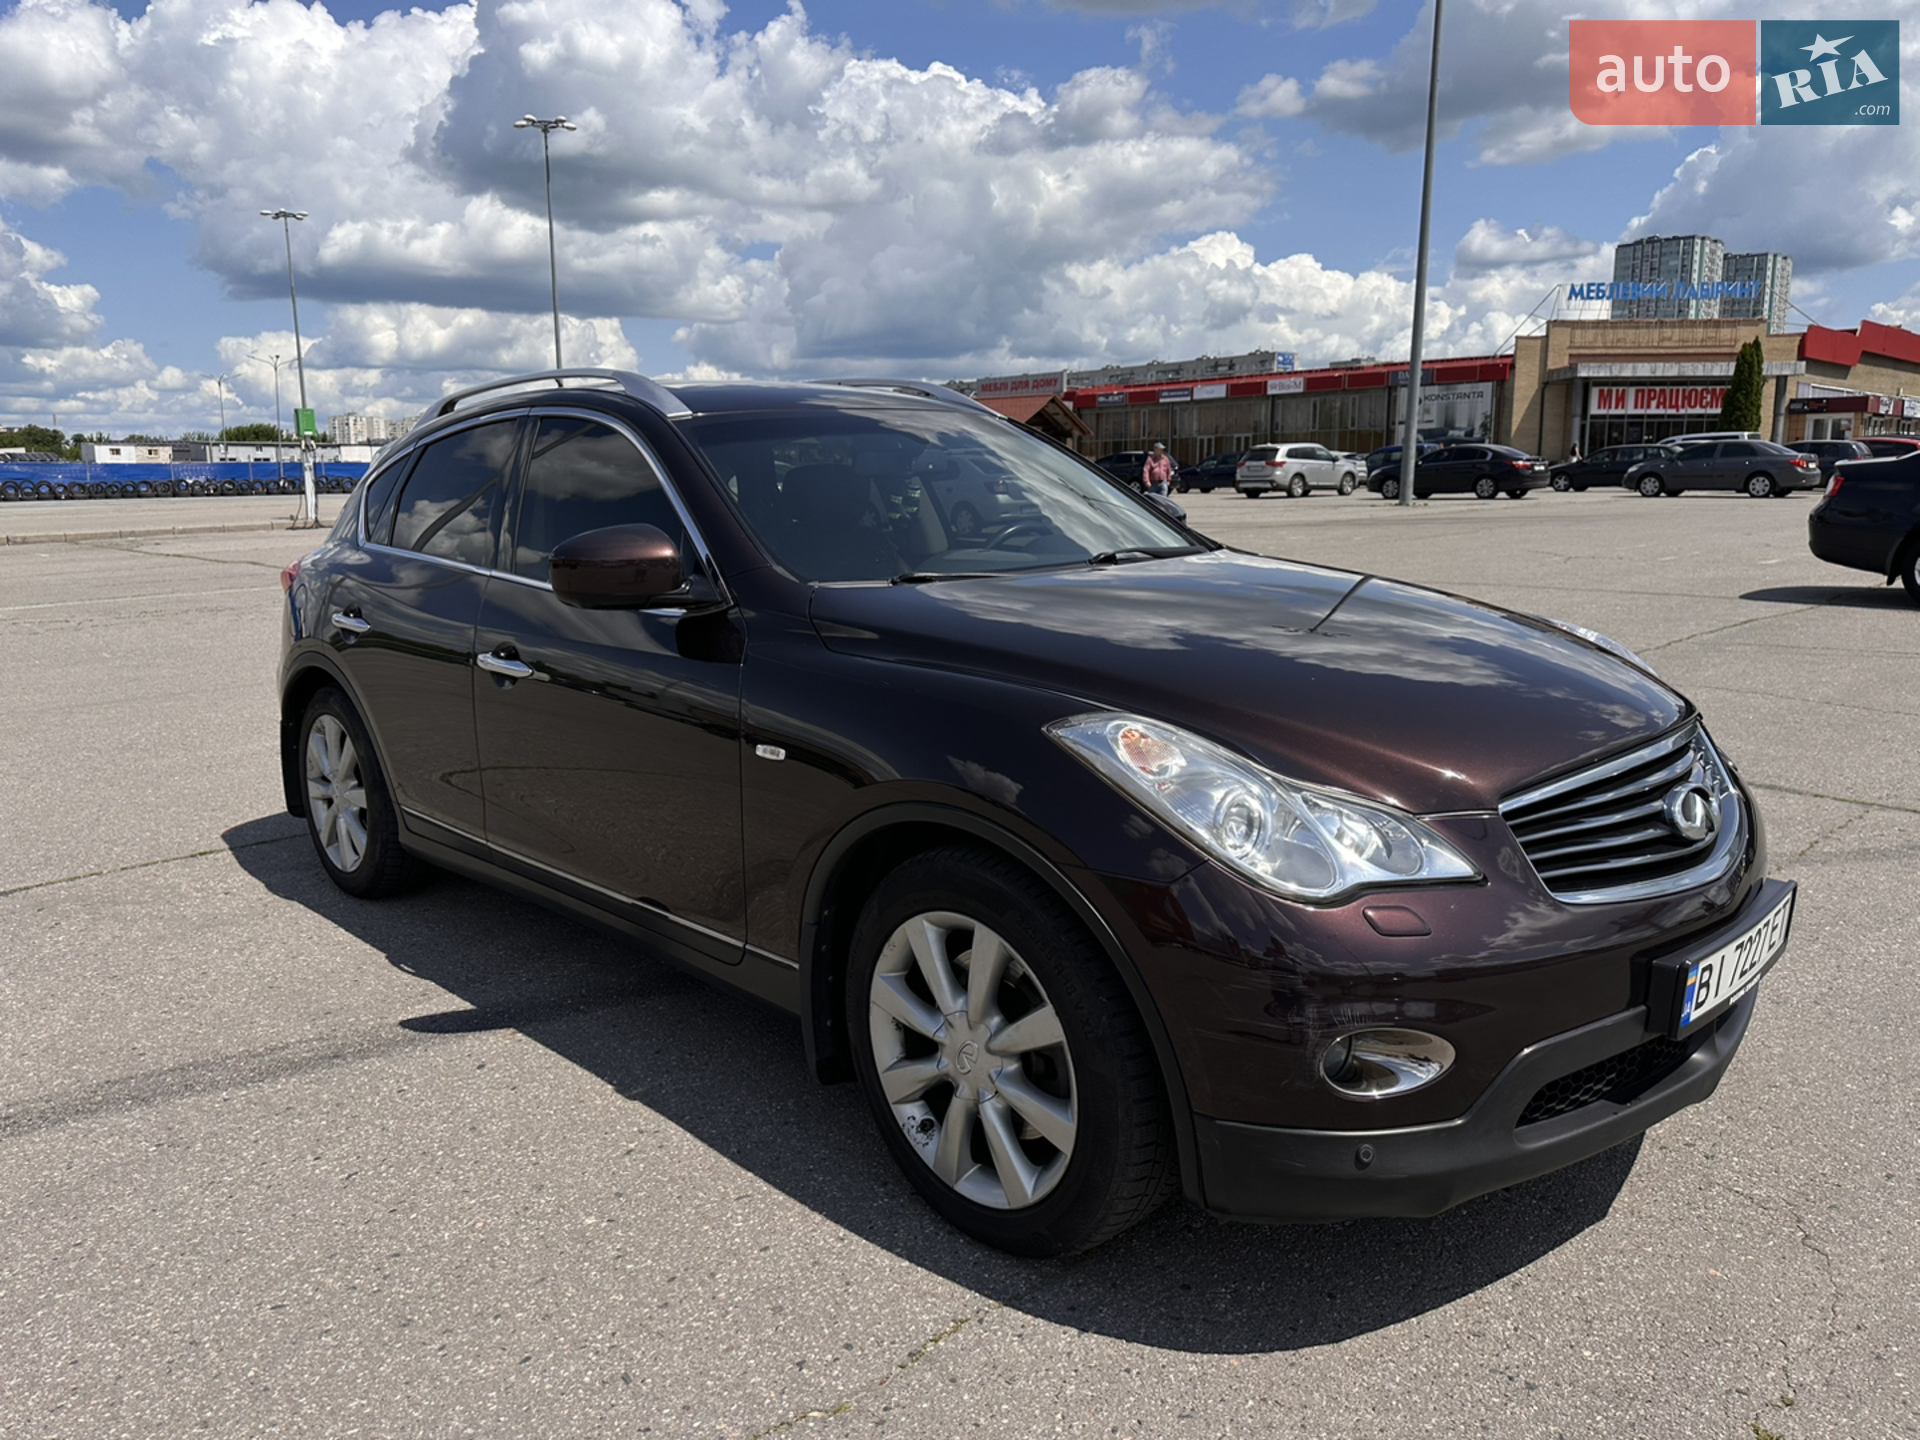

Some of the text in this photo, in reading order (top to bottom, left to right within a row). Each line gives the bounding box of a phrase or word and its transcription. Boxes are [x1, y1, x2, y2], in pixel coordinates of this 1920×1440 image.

[1568, 280, 1761, 301] МЕБЛЕВИЙ ЛАБІРИНТ
[981, 378, 1059, 393] МЕБЛІ ДЛЯ ДОМУ
[1423, 391, 1484, 402] KONSTANTA
[1597, 387, 1726, 412] МИ ПРАЦЮЄМ
[1693, 953, 1726, 1011] BI
[1728, 918, 1771, 988] 7227
[1767, 898, 1790, 953] ET
